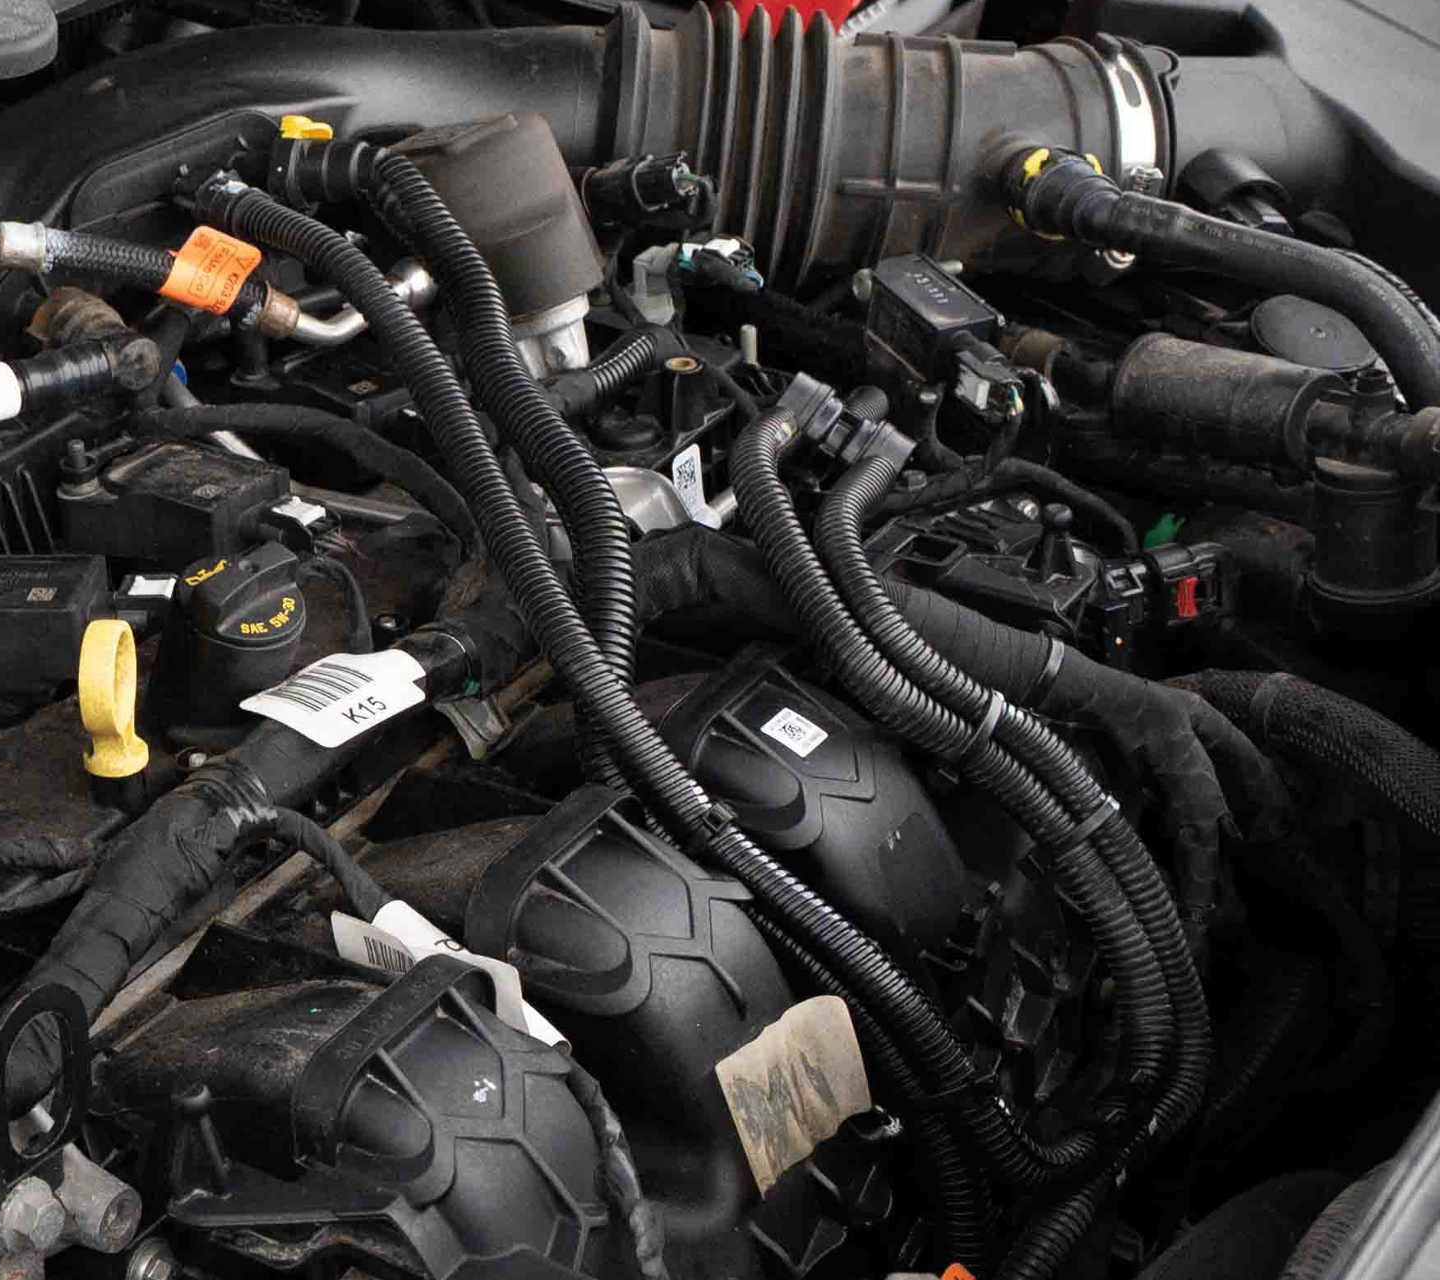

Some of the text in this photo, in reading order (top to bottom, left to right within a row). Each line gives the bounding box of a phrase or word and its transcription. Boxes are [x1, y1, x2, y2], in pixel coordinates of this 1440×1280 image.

[240, 597, 296, 635] SAE 5W-30
[342, 695, 388, 725] K15
